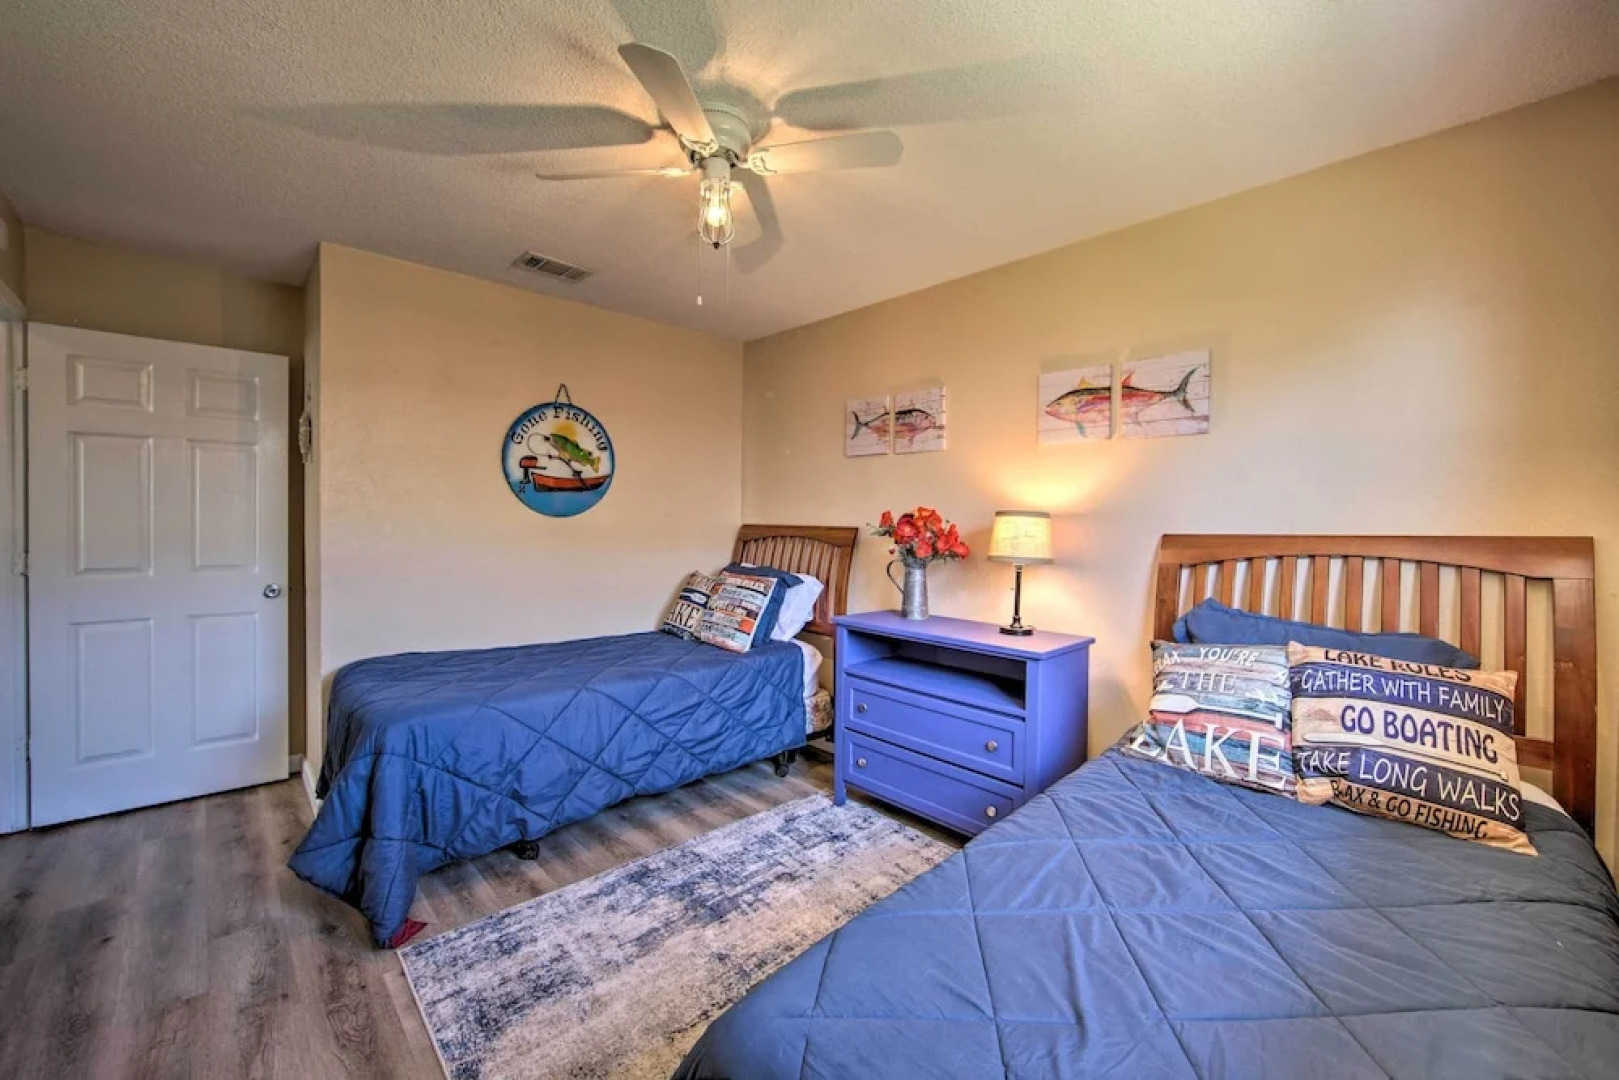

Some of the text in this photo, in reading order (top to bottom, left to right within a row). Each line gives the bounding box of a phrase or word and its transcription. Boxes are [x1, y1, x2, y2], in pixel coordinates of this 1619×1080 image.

[512, 405, 607, 451] Gone Fishing
[666, 602, 700, 629] AKE
[1199, 647, 1259, 666] YOU'RE
[1324, 649, 1472, 682] LAKE RULES
[1178, 671, 1237, 694] THE
[1301, 668, 1377, 694] GATHER
[1380, 677, 1431, 704] WITH
[1438, 686, 1505, 723] FAMILY
[1341, 705, 1498, 764] GO BOATING
[1299, 752, 1521, 821] TAKE LONG WALKS
[1367, 791, 1380, 809] &
[1385, 796, 1411, 817] GO
[1414, 804, 1488, 839] FISHING
